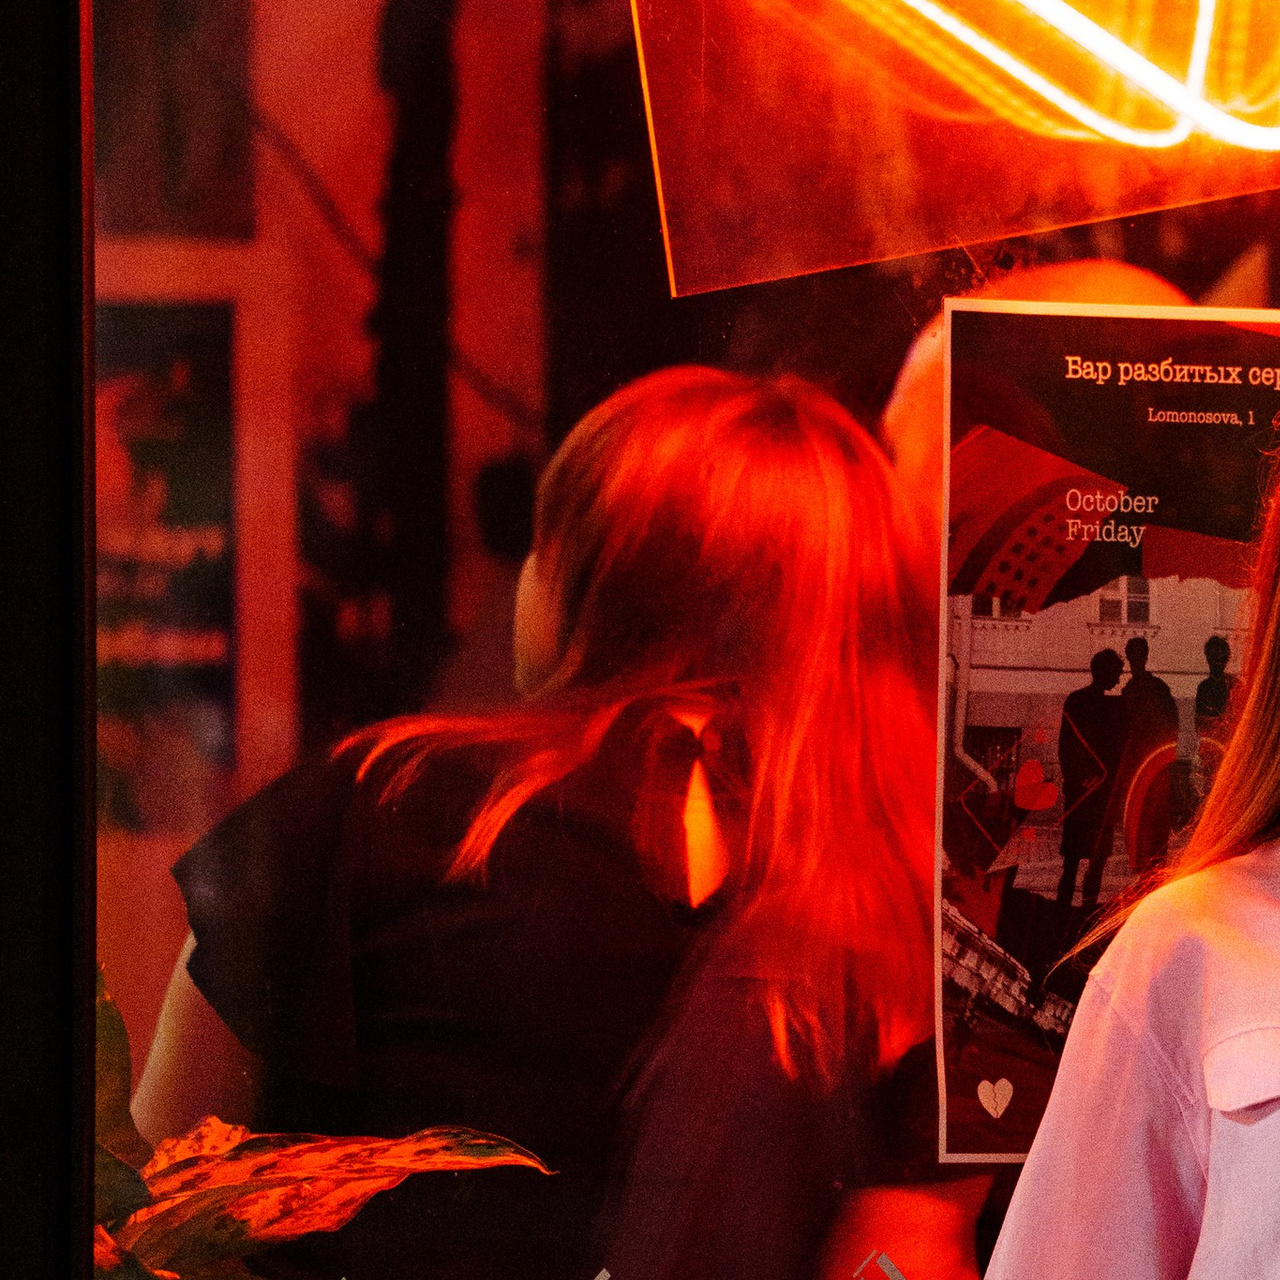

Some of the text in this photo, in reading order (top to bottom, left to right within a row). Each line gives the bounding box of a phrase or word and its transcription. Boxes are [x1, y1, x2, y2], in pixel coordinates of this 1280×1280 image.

[1065, 355, 1112, 385] Бар
[1117, 357, 1243, 386] разбитых
[1148, 408, 1243, 427] Lomonosova,
[1065, 488, 1160, 513] October
[1065, 519, 1146, 548] Friday
